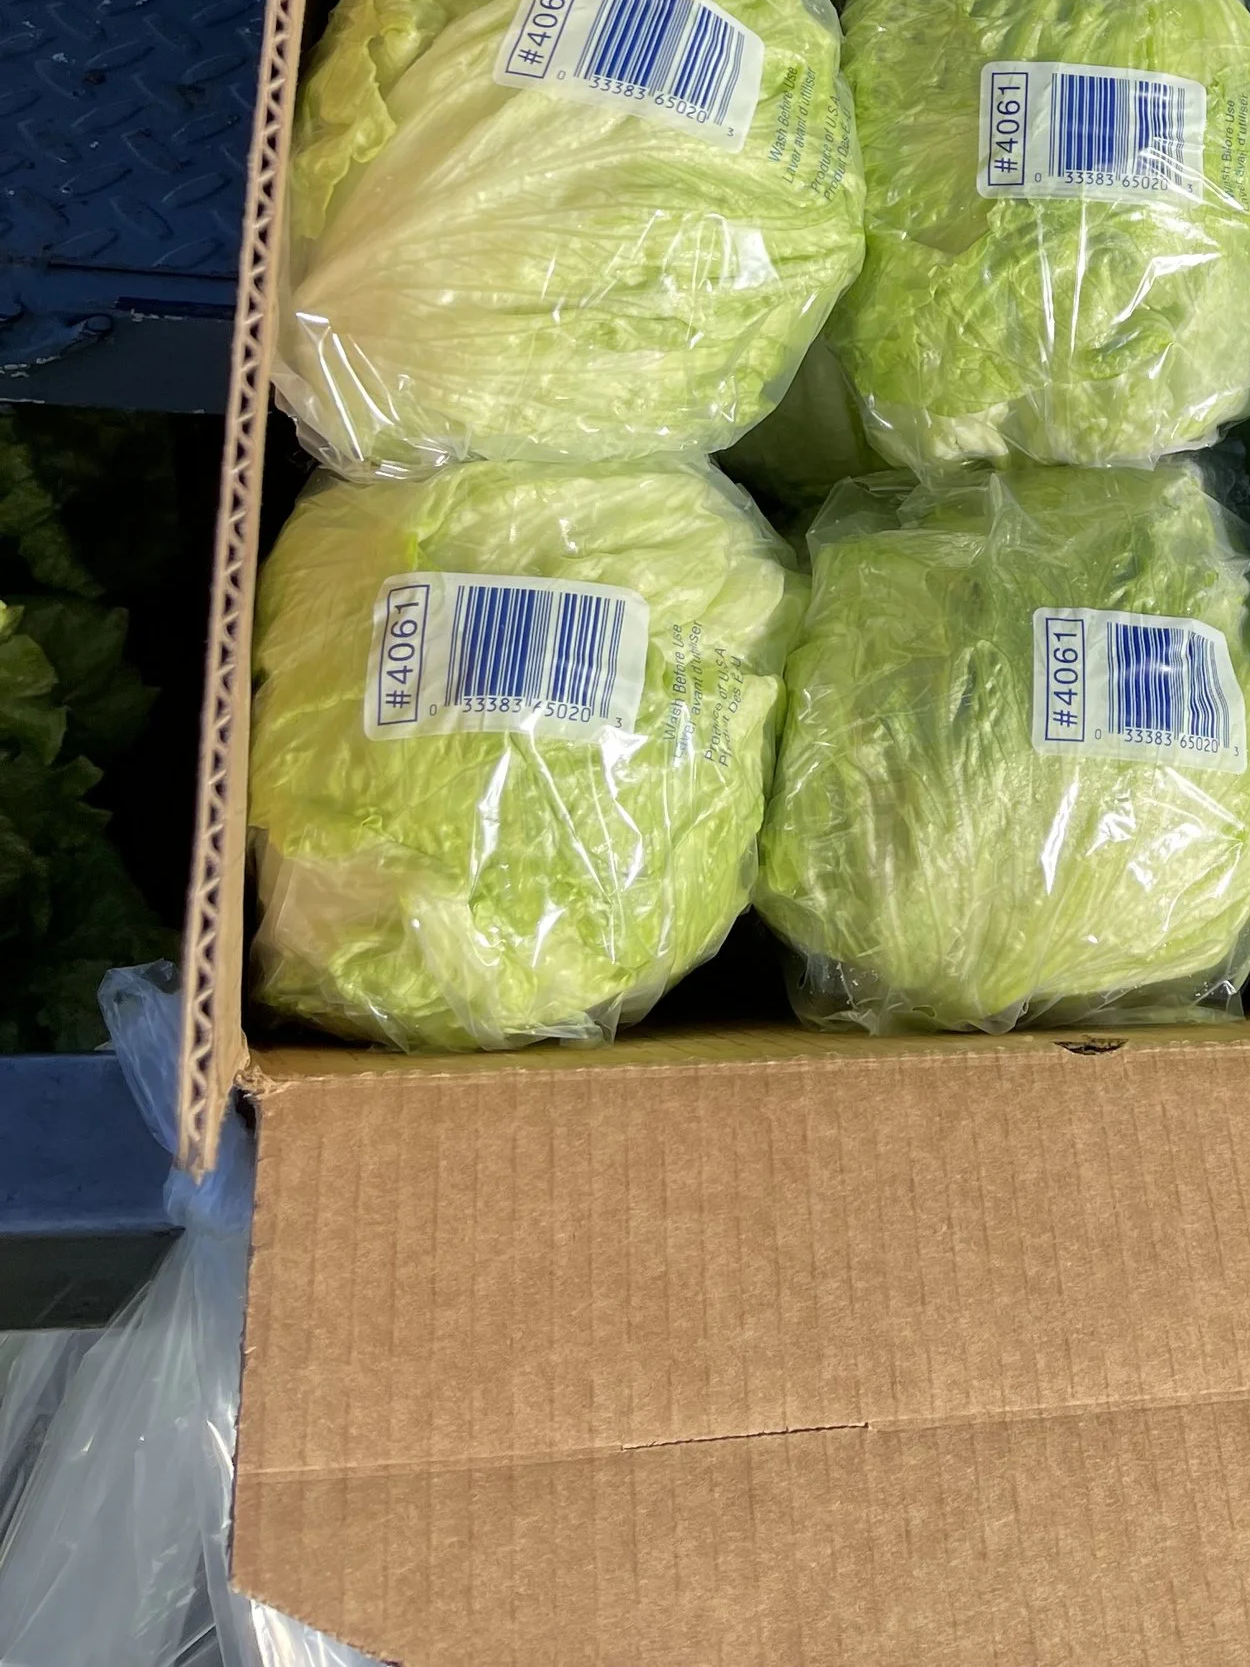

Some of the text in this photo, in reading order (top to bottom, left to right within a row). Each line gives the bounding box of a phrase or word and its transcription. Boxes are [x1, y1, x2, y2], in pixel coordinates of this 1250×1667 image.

[557, 70, 734, 137] 0 33383 65020 3
[768, 66, 798, 162] Wash Before Use
[782, 66, 816, 184] Laver avant d'utiliser
[994, 85, 1021, 174] #4061
[1225, 100, 1235, 123] Use
[1237, 94, 1248, 145] d'utiliser
[810, 144, 832, 194] Produce
[824, 127, 834, 144] of
[824, 157, 847, 202] Produit
[837, 134, 850, 158] Des
[1034, 172, 1193, 193] 0 33383 65020 3
[385, 601, 419, 708] #4061
[689, 620, 703, 675] d'utiliser
[664, 624, 687, 741] Wash Before Use
[692, 677, 703, 715] avant
[717, 683, 728, 700] of
[728, 690, 742, 714] Des
[1053, 631, 1079, 728] #4061
[429, 704, 437, 716] 0
[462, 697, 523, 713] 33383
[615, 717, 623, 728] 3
[1095, 728, 1239, 756] 0 33383 65020 3
